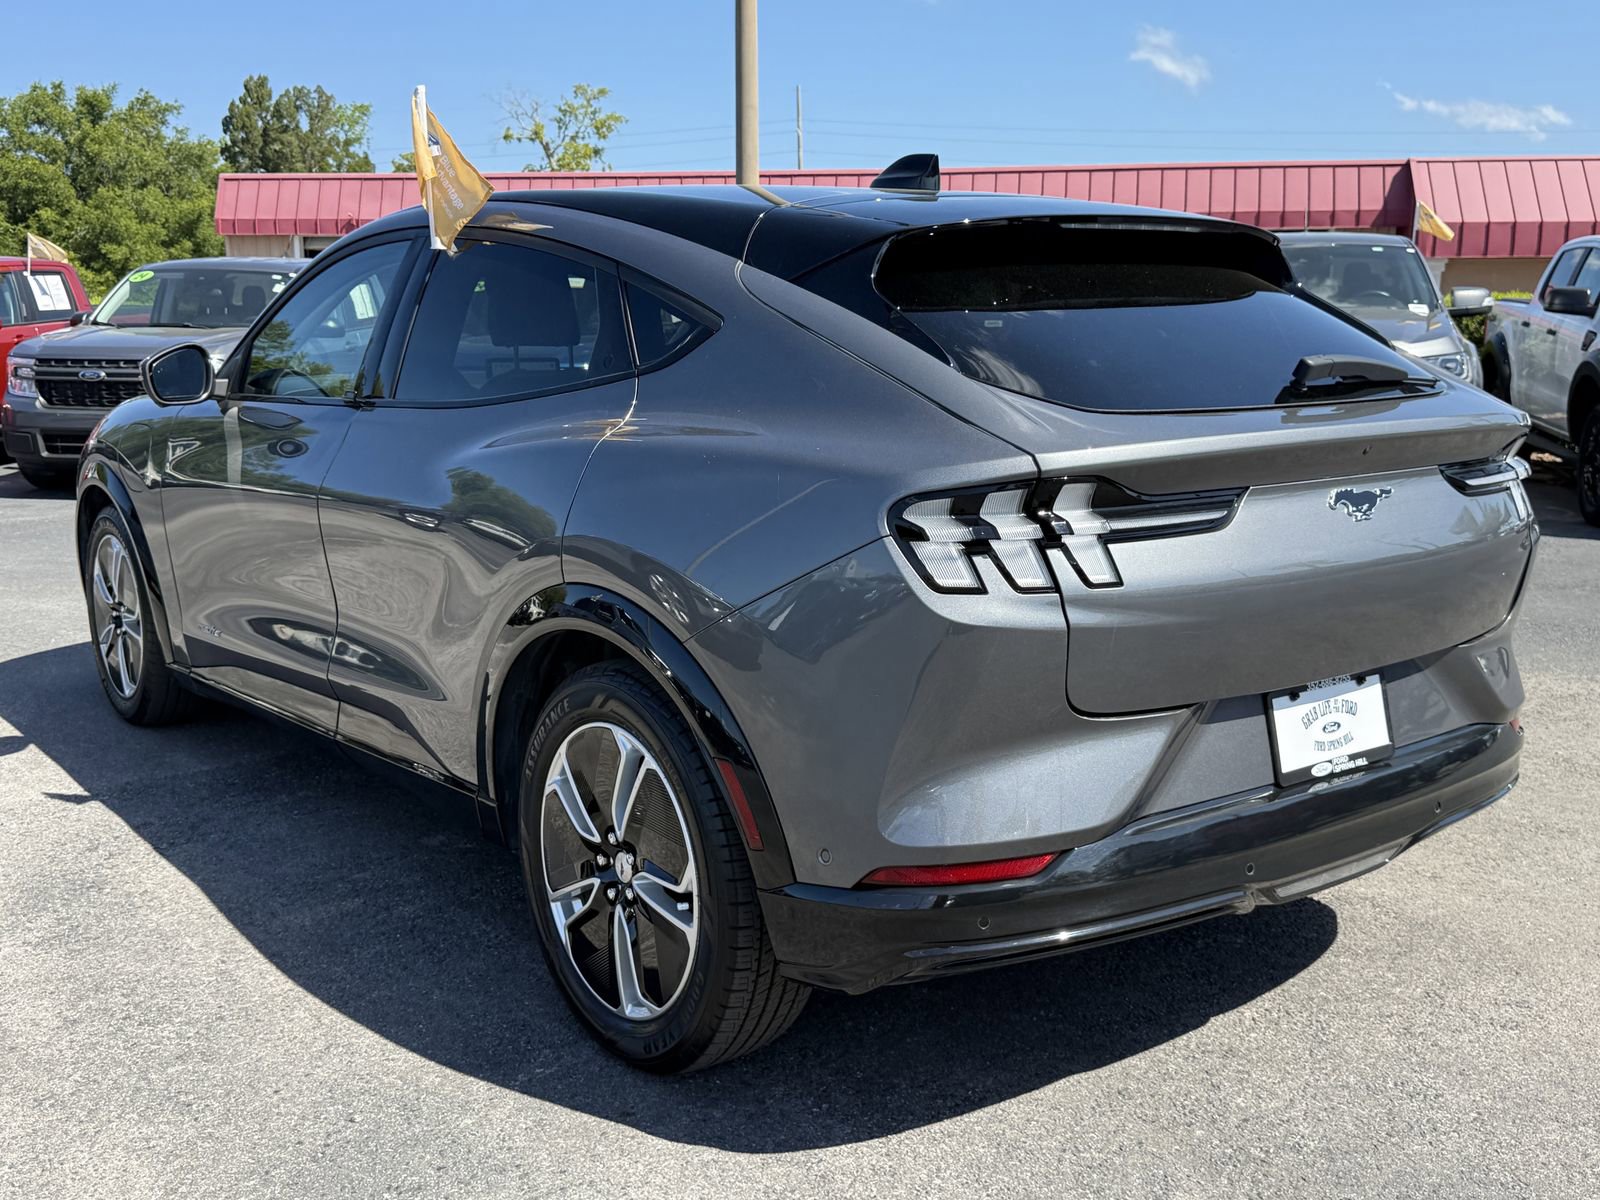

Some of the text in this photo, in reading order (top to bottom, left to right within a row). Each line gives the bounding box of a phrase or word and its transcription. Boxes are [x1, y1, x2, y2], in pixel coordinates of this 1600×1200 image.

[440, 154, 456, 177] Blue
[1301, 706, 1319, 730] GRAB
[1318, 699, 1333, 717] LIFE
[1341, 699, 1358, 717] FORD
[525, 698, 570, 784] ASSURANCE
[1333, 755, 1349, 765] FORD
[1334, 757, 1368, 773] SPRING HILL
